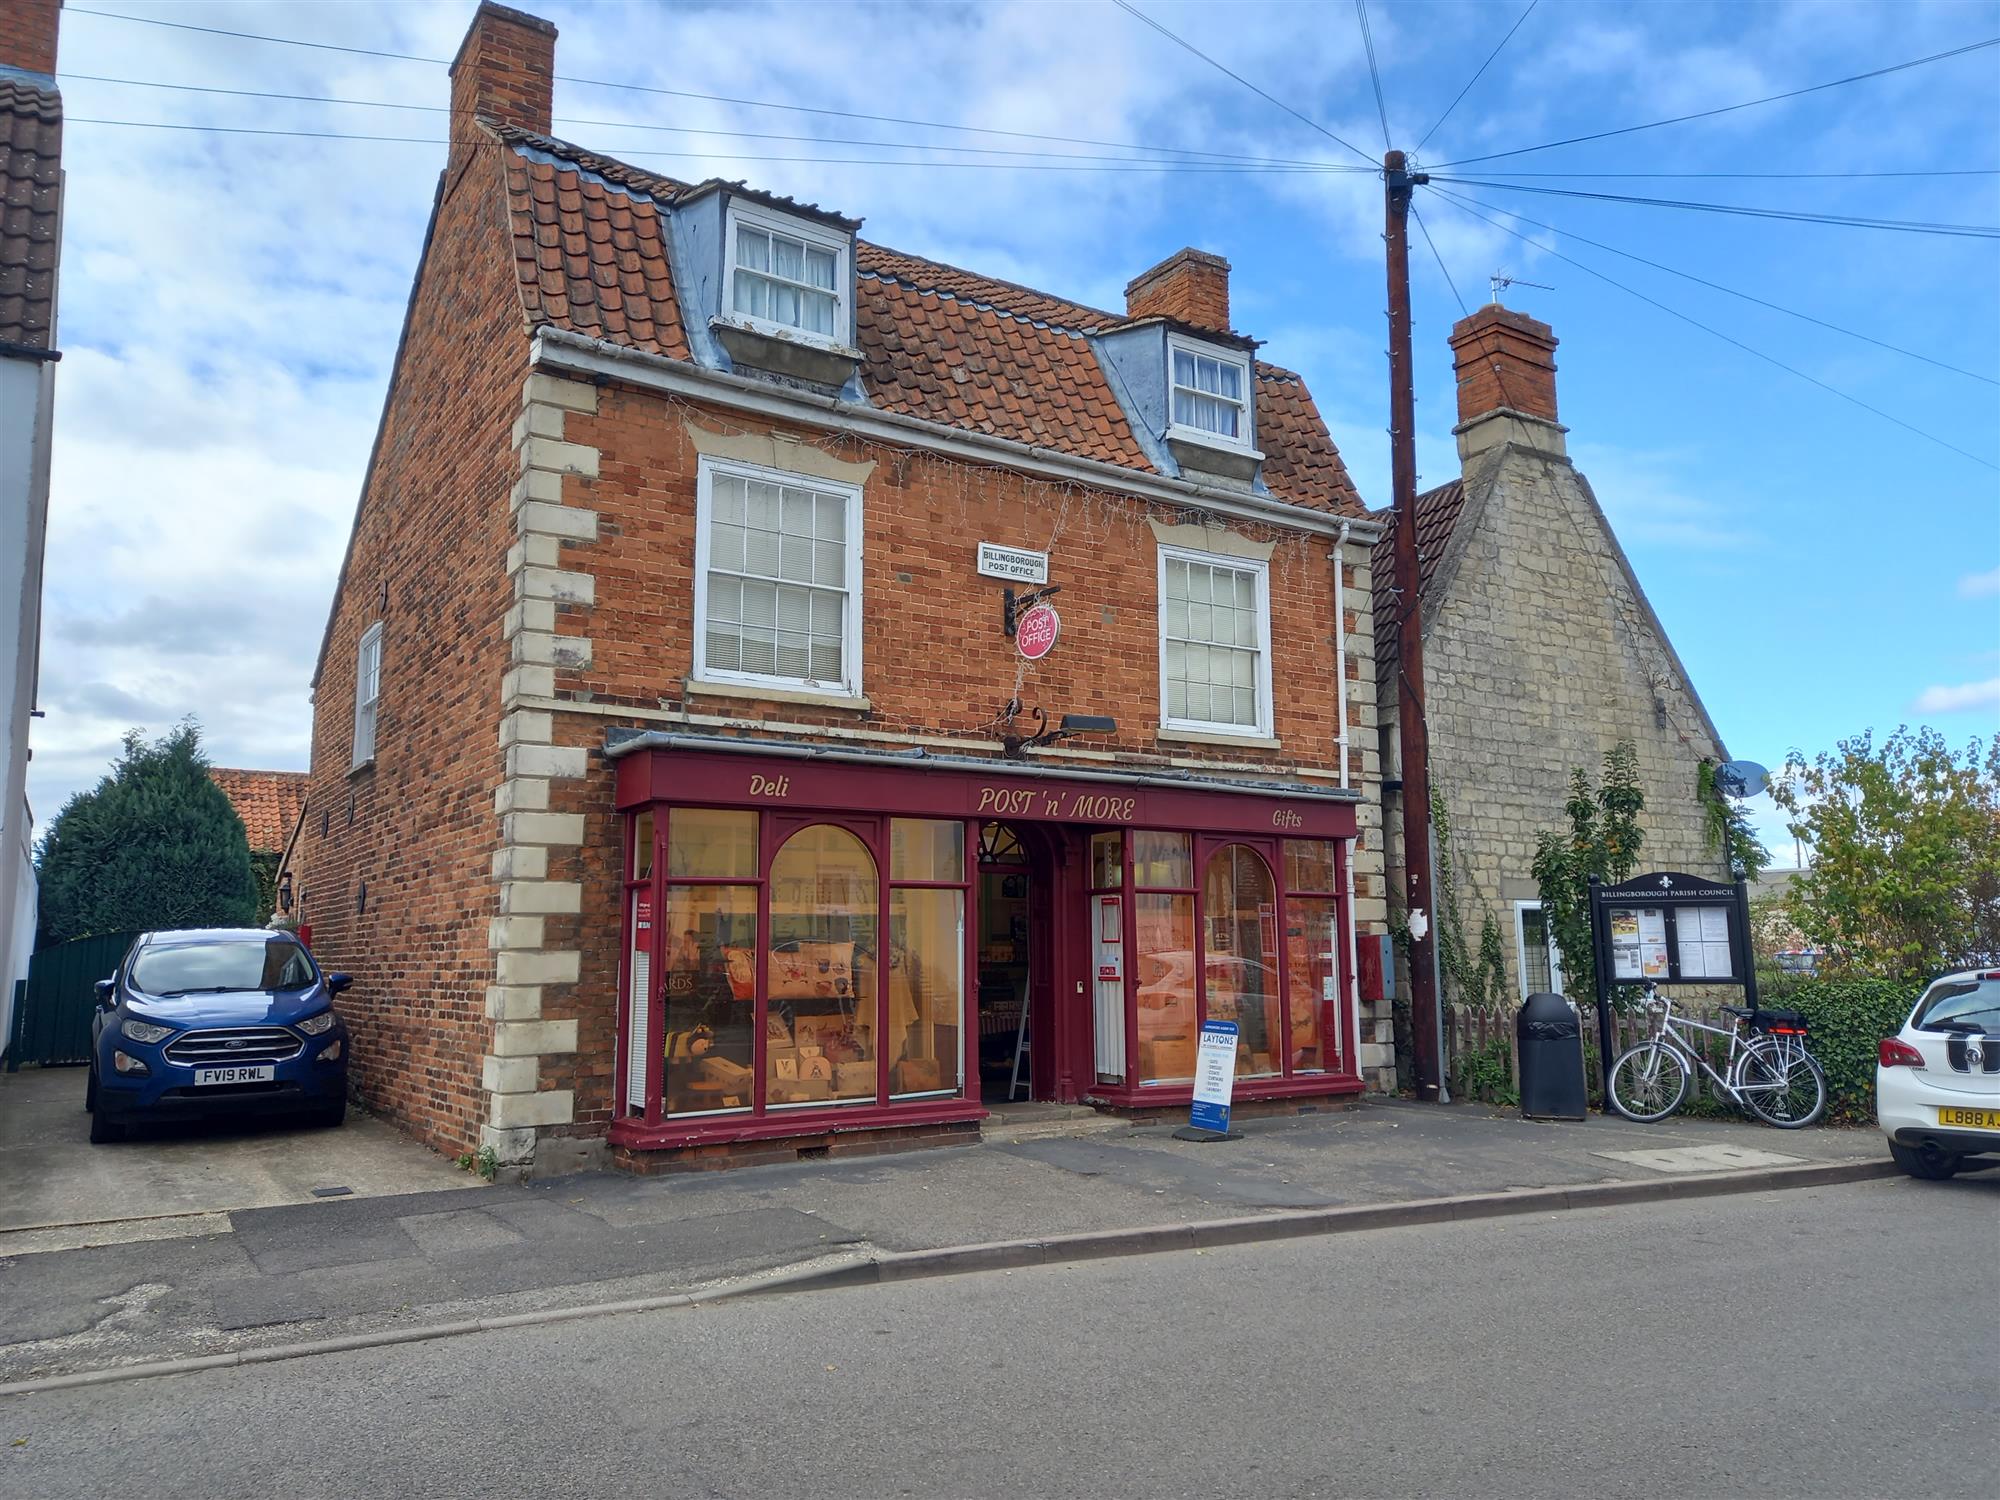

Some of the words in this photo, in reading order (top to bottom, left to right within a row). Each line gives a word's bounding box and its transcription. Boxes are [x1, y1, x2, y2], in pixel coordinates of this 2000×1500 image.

[983, 551, 1044, 568] BILLINGBOROUGH
[988, 563, 1009, 572] POST
[1010, 565, 1035, 576] OFFICE
[1026, 617, 1050, 633] POST
[1021, 630, 1051, 647] OFFICE
[749, 774, 789, 797] Deli
[977, 787, 1037, 814] POST
[1069, 795, 1135, 821] MORE
[1272, 809, 1303, 829] Gifts
[1601, 890, 1668, 898] BILLINGBOROUGH
[1670, 889, 1697, 897] PARISH
[1699, 888, 1735, 896] COUNCIL
[1203, 1034, 1234, 1046] LAYTONS
[203, 1069, 235, 1082] FV19
[238, 1068, 265, 1080] RWL
[1945, 1109, 1984, 1125] L888
